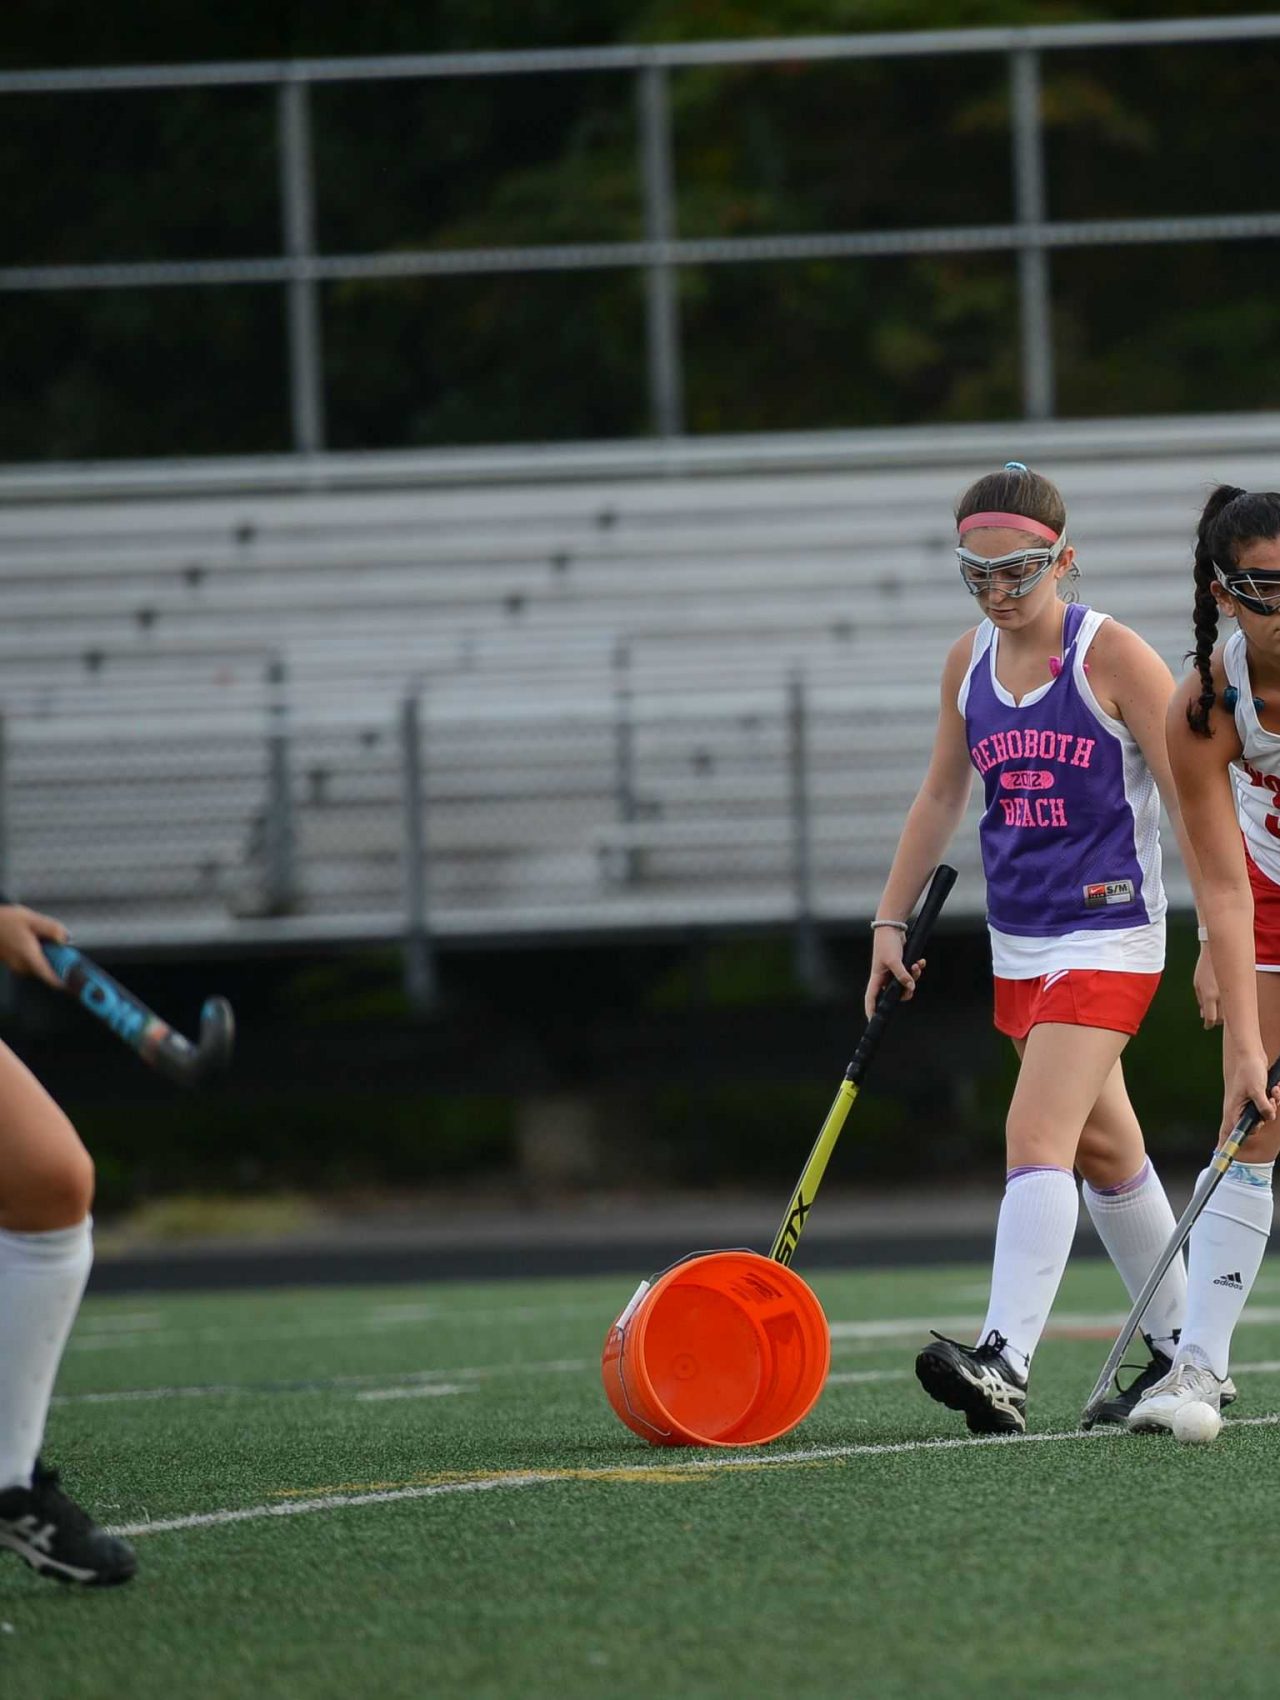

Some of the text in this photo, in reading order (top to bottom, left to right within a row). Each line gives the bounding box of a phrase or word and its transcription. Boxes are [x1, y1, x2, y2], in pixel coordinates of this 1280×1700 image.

[971, 729, 1096, 775] REHOBOTH
[999, 797, 1068, 828] BEACH
[1106, 883, 1128, 894] S/M
[775, 1189, 814, 1267] STX
[1213, 1279, 1243, 1291] adidas
